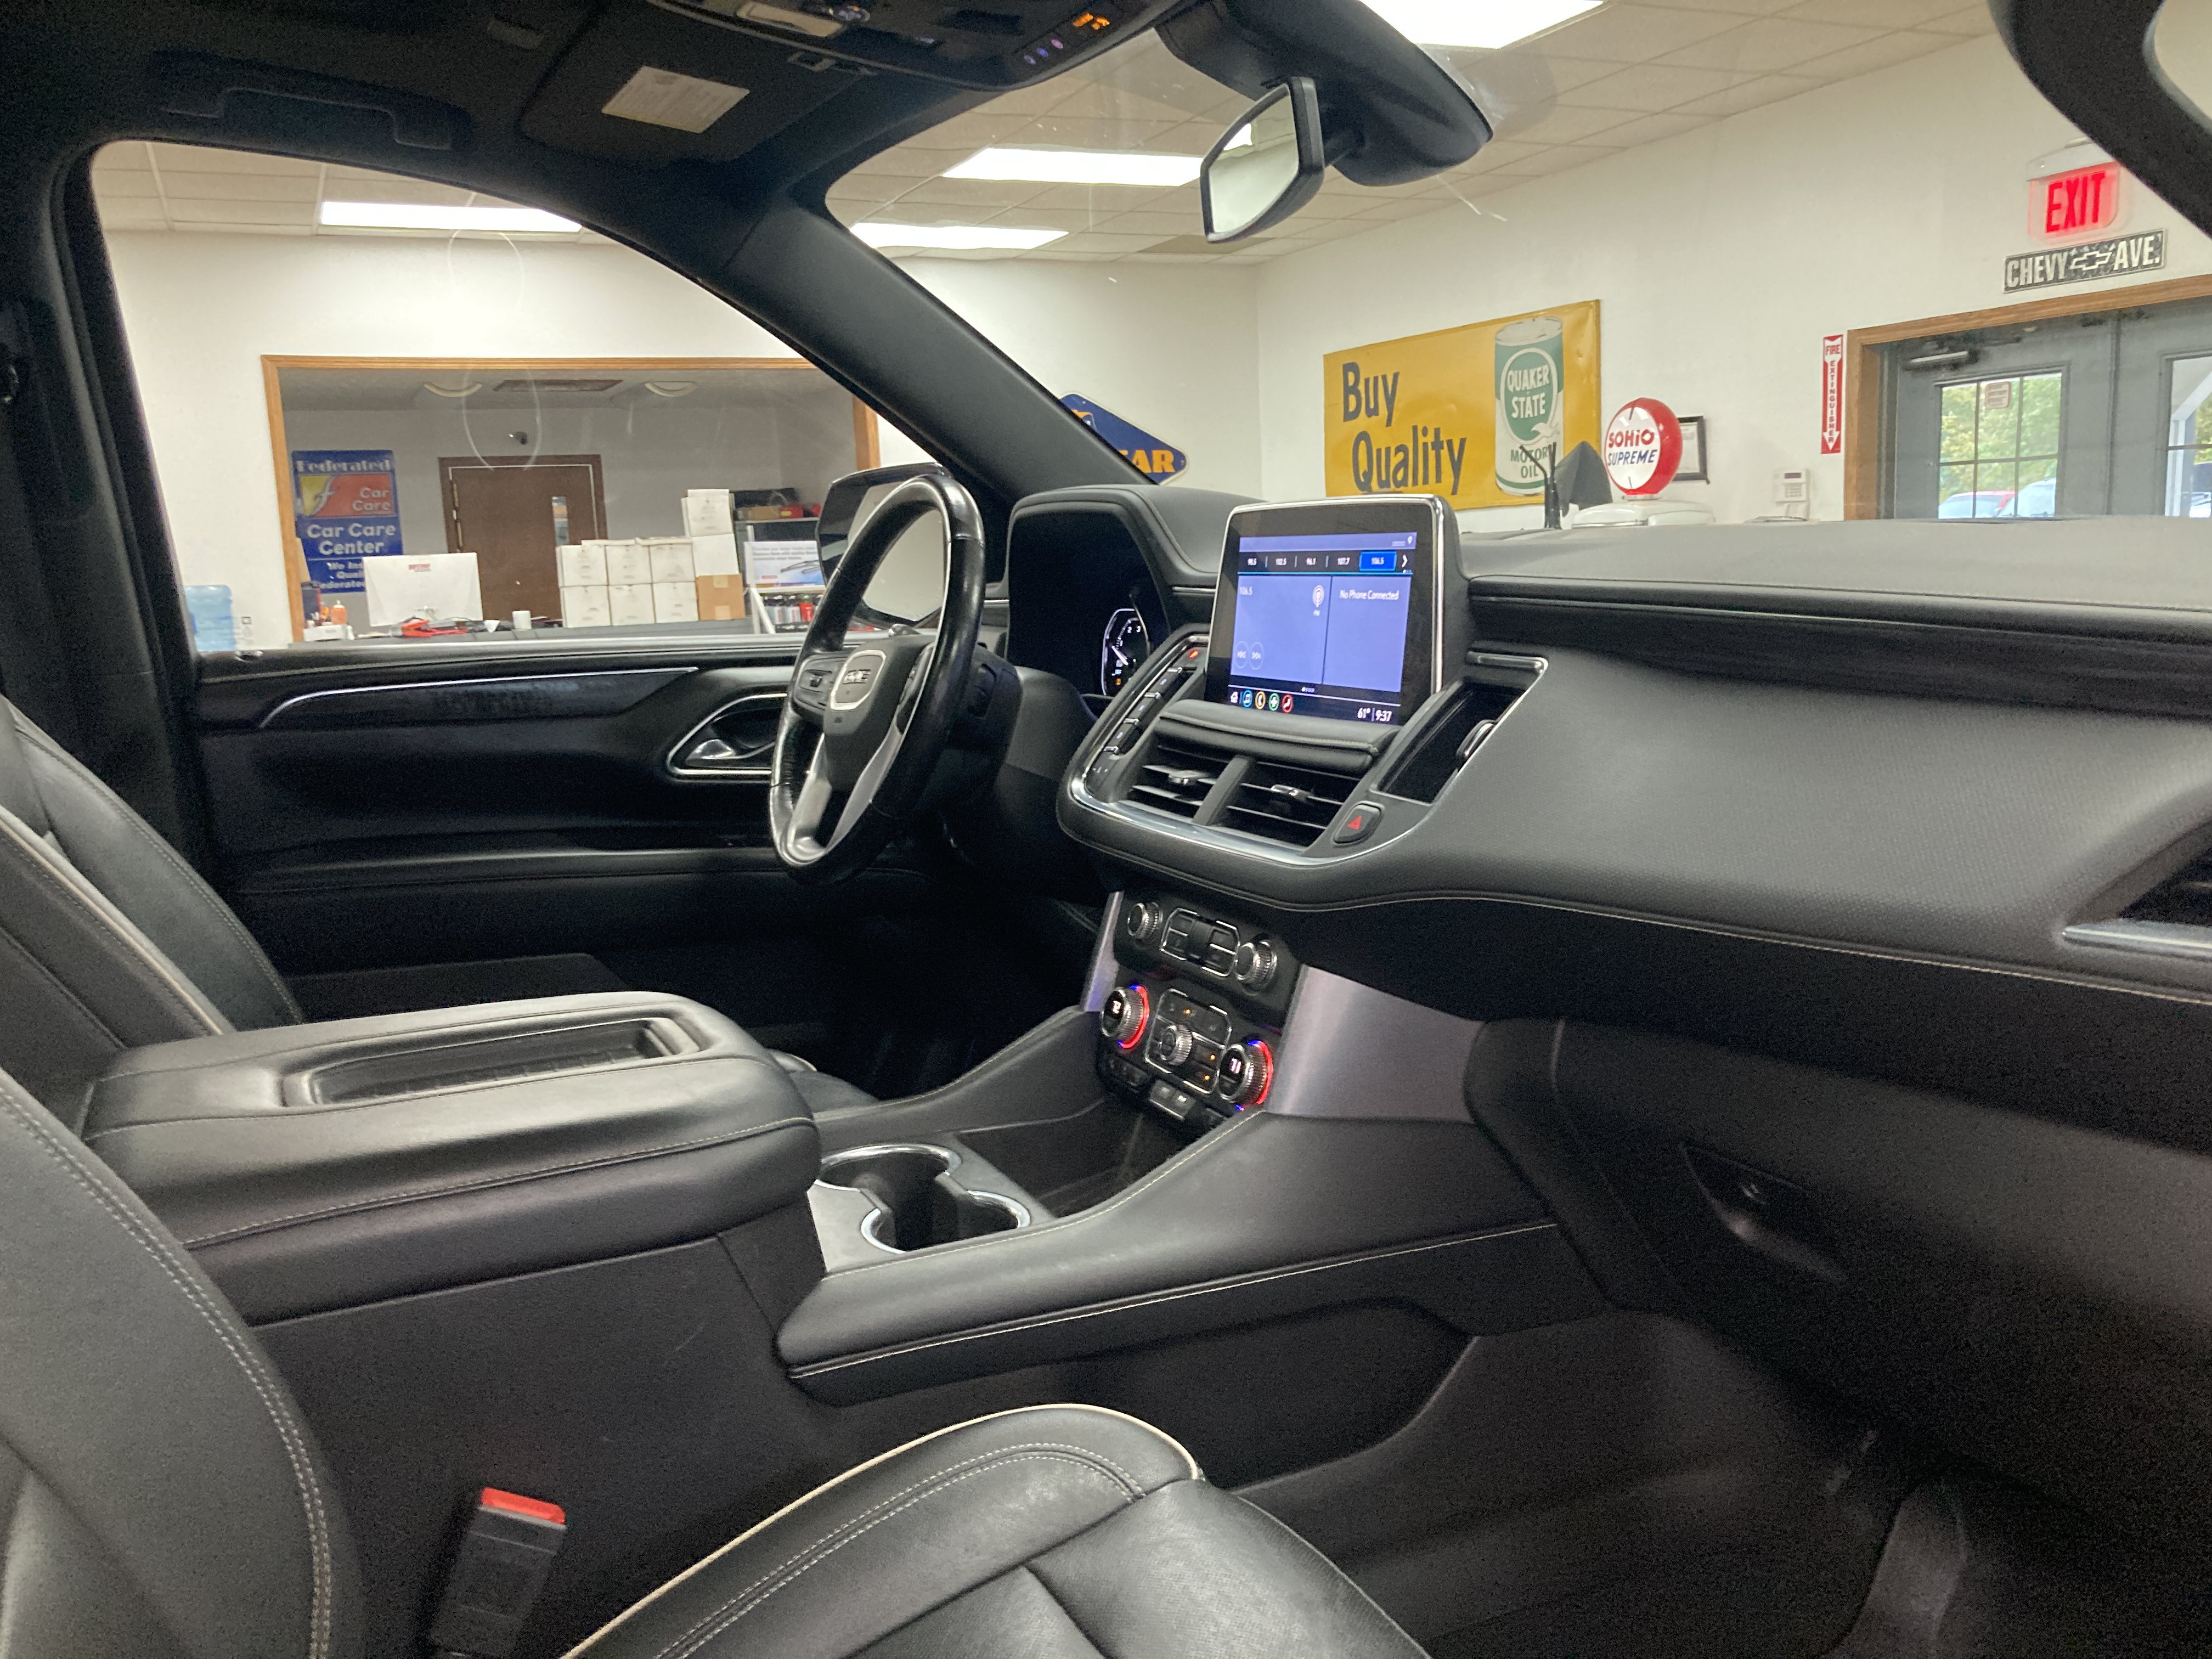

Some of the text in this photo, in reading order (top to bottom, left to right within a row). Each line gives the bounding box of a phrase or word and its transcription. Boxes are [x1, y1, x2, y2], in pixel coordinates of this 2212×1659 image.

[2045, 171, 2106, 234] EXIT
[2006, 251, 2069, 287] CHEVY
[1825, 345, 1841, 356] FIRE
[1507, 364, 1550, 393] QUAKER
[1342, 362, 1400, 427] Buy
[1511, 392, 1546, 419] STATE
[1352, 425, 1467, 495] Quality
[1510, 446, 1548, 463] MOTOR
[1607, 449, 1658, 466] SUPREME
[296, 459, 391, 472] Federated
[1520, 465, 1539, 479] OIL
[359, 487, 390, 499] Car
[352, 500, 391, 512] Care
[306, 523, 396, 538] Car Care
[318, 540, 385, 555] Center
[1339, 590, 1400, 600] No Phone Connected
